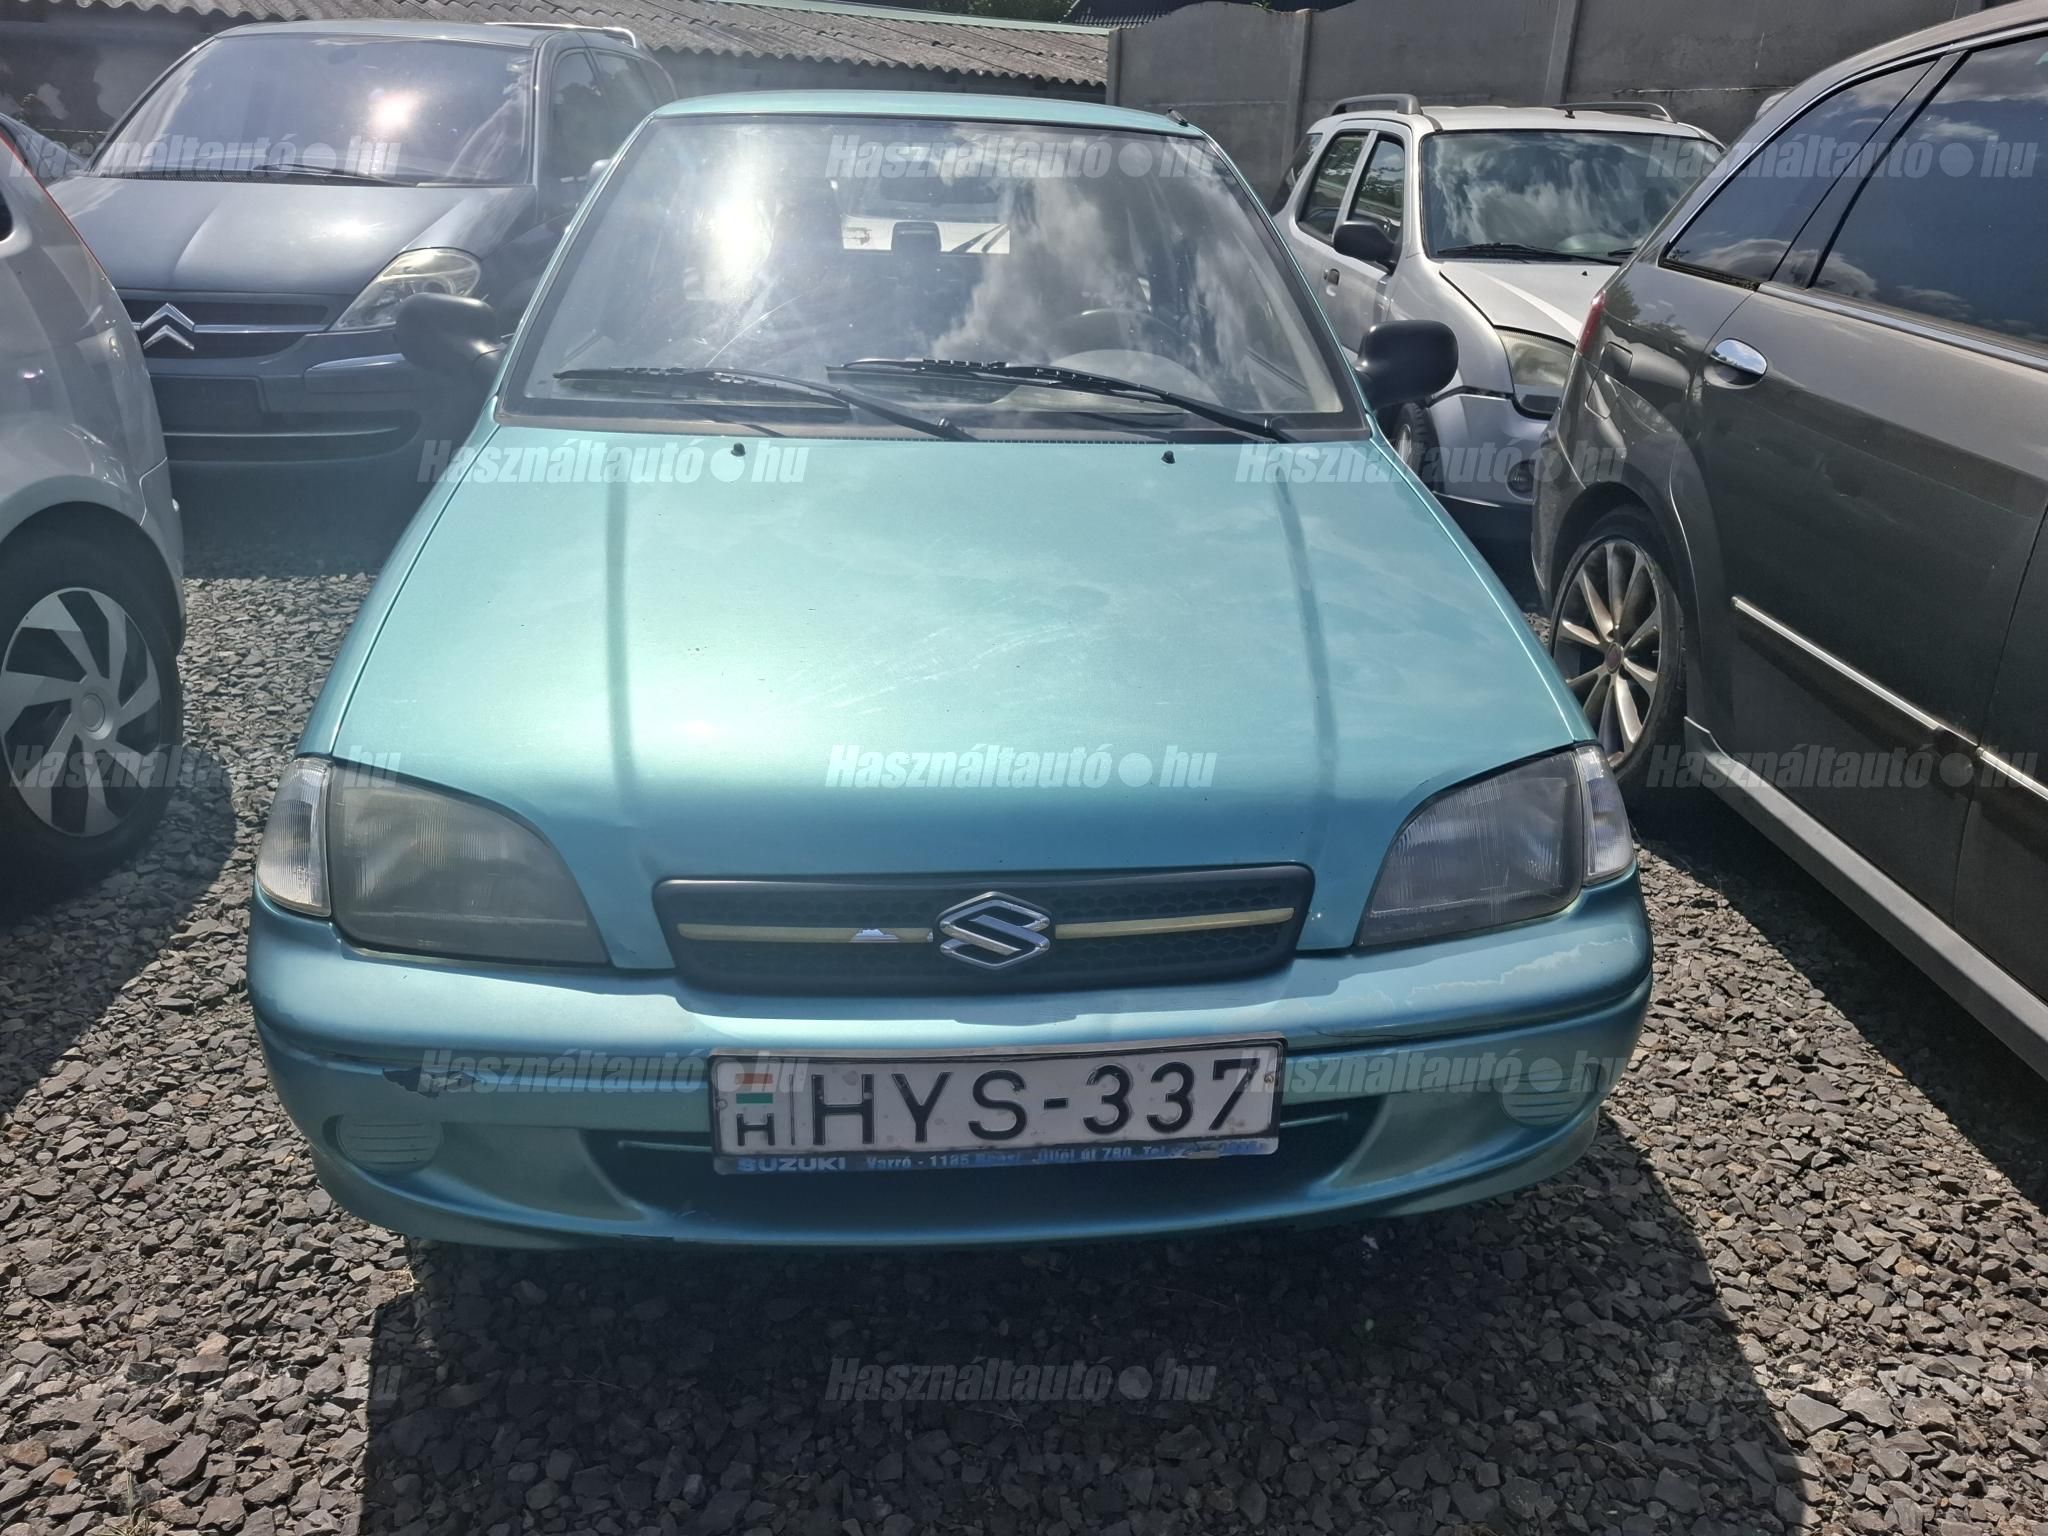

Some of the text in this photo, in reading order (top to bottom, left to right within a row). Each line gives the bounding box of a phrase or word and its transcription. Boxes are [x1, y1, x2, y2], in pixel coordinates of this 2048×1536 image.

[811, 1057, 1261, 1146] HYS-337
[736, 1113, 776, 1146] H
[736, 1157, 846, 1172] SUZUKI
